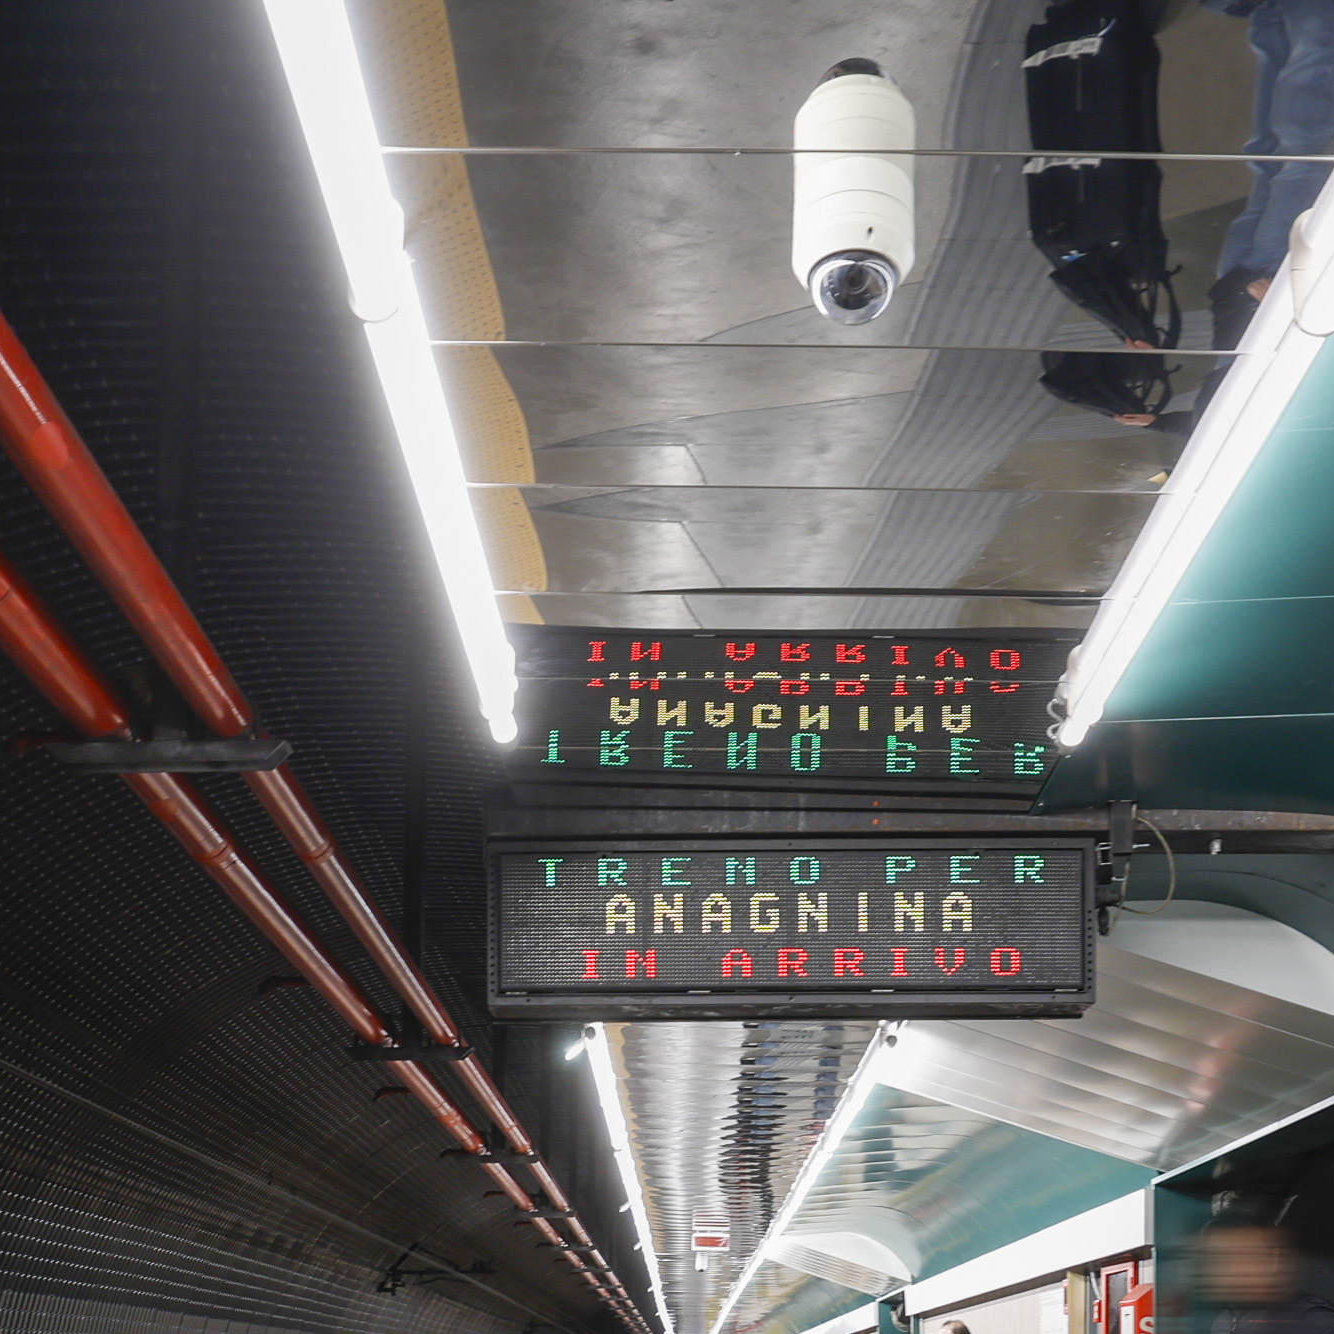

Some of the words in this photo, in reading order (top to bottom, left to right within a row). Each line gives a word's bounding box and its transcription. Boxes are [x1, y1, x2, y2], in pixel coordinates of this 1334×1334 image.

[538, 857, 820, 886] TRENO
[886, 855, 1045, 885] PER
[605, 892, 973, 934] ANAGNINA
[581, 948, 657, 979] IN
[721, 947, 1022, 978] ARRIVO
